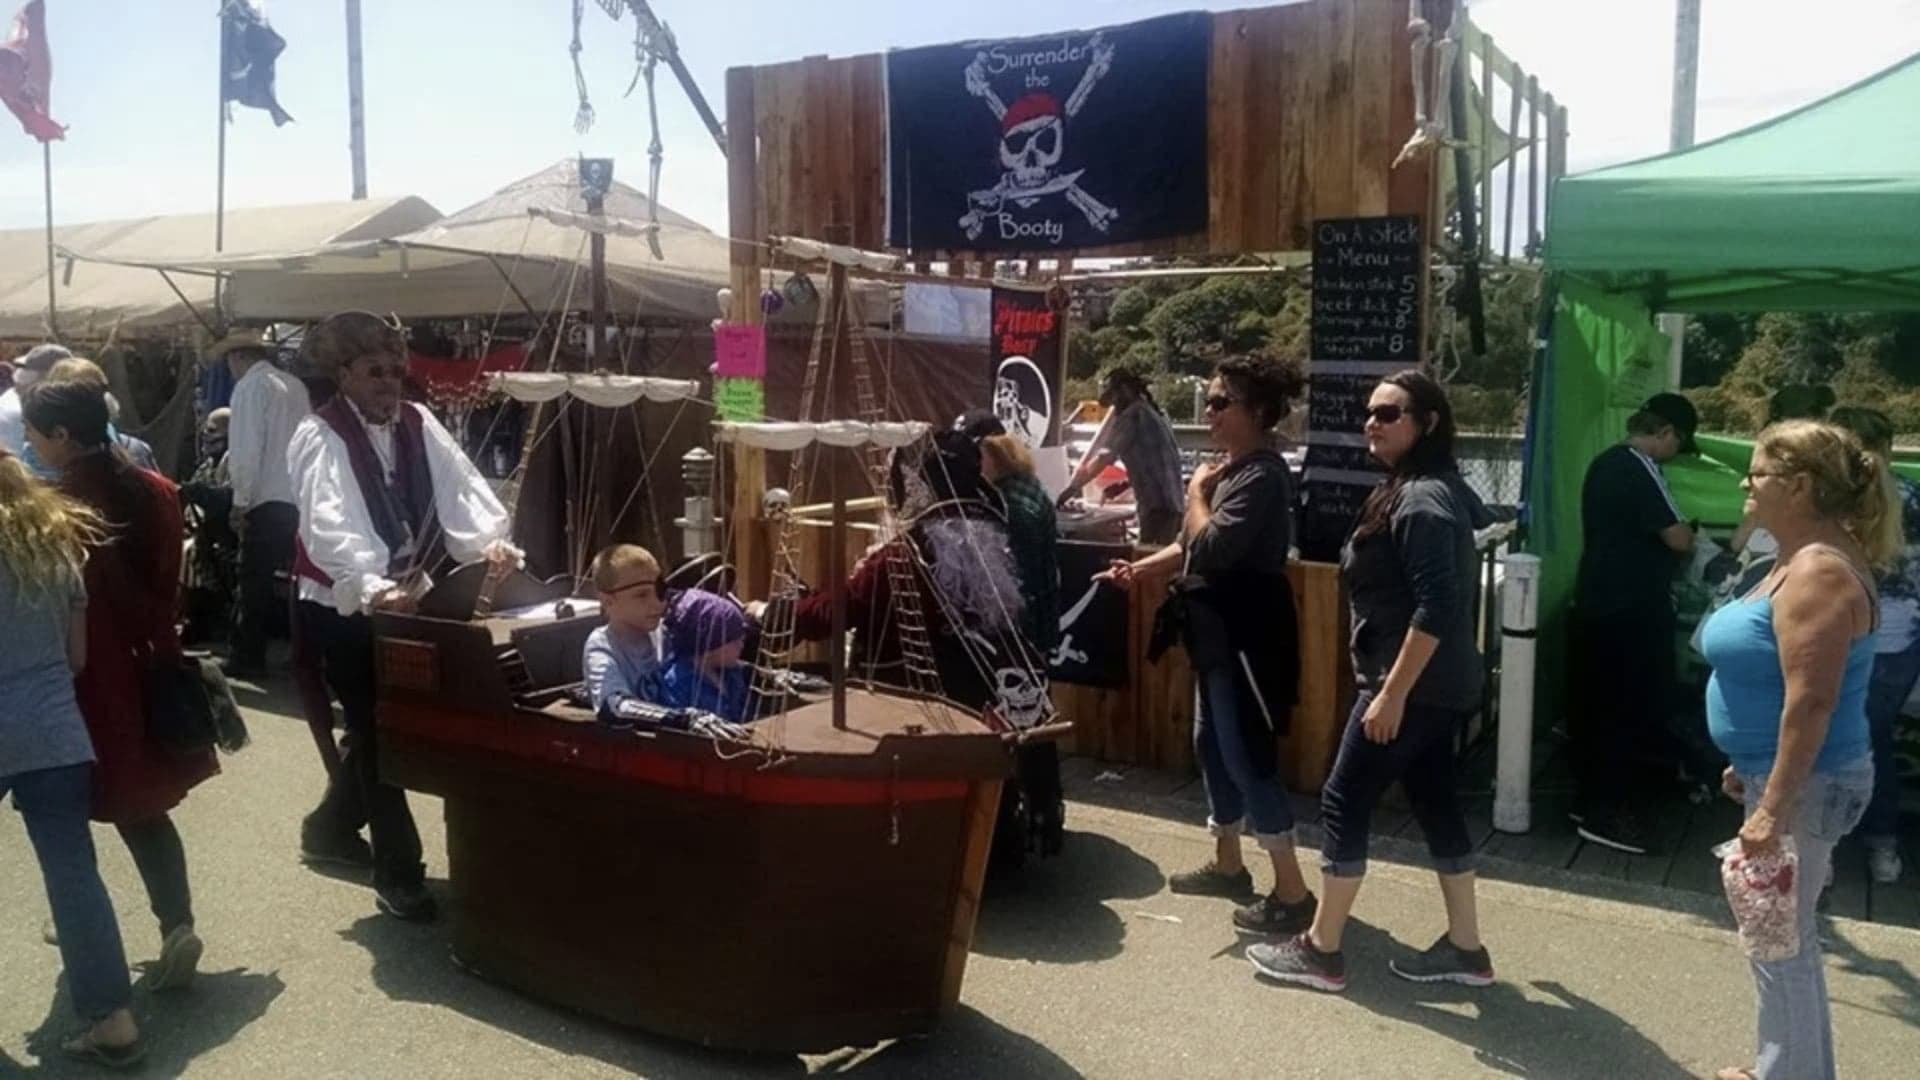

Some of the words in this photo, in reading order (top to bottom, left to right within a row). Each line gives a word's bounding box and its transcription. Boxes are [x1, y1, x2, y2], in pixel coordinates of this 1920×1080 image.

[987, 45, 1089, 73] Surrender
[1025, 68, 1049, 88] the
[998, 213, 1063, 244] Booty
[1318, 223, 1347, 245] On
[1352, 224, 1363, 243] A
[1369, 220, 1418, 245] Stick
[1336, 247, 1390, 267] Menu
[1400, 275, 1417, 293] 5
[1396, 296, 1414, 314] 5
[1395, 314, 1406, 329] 8
[1389, 334, 1404, 353] 8
